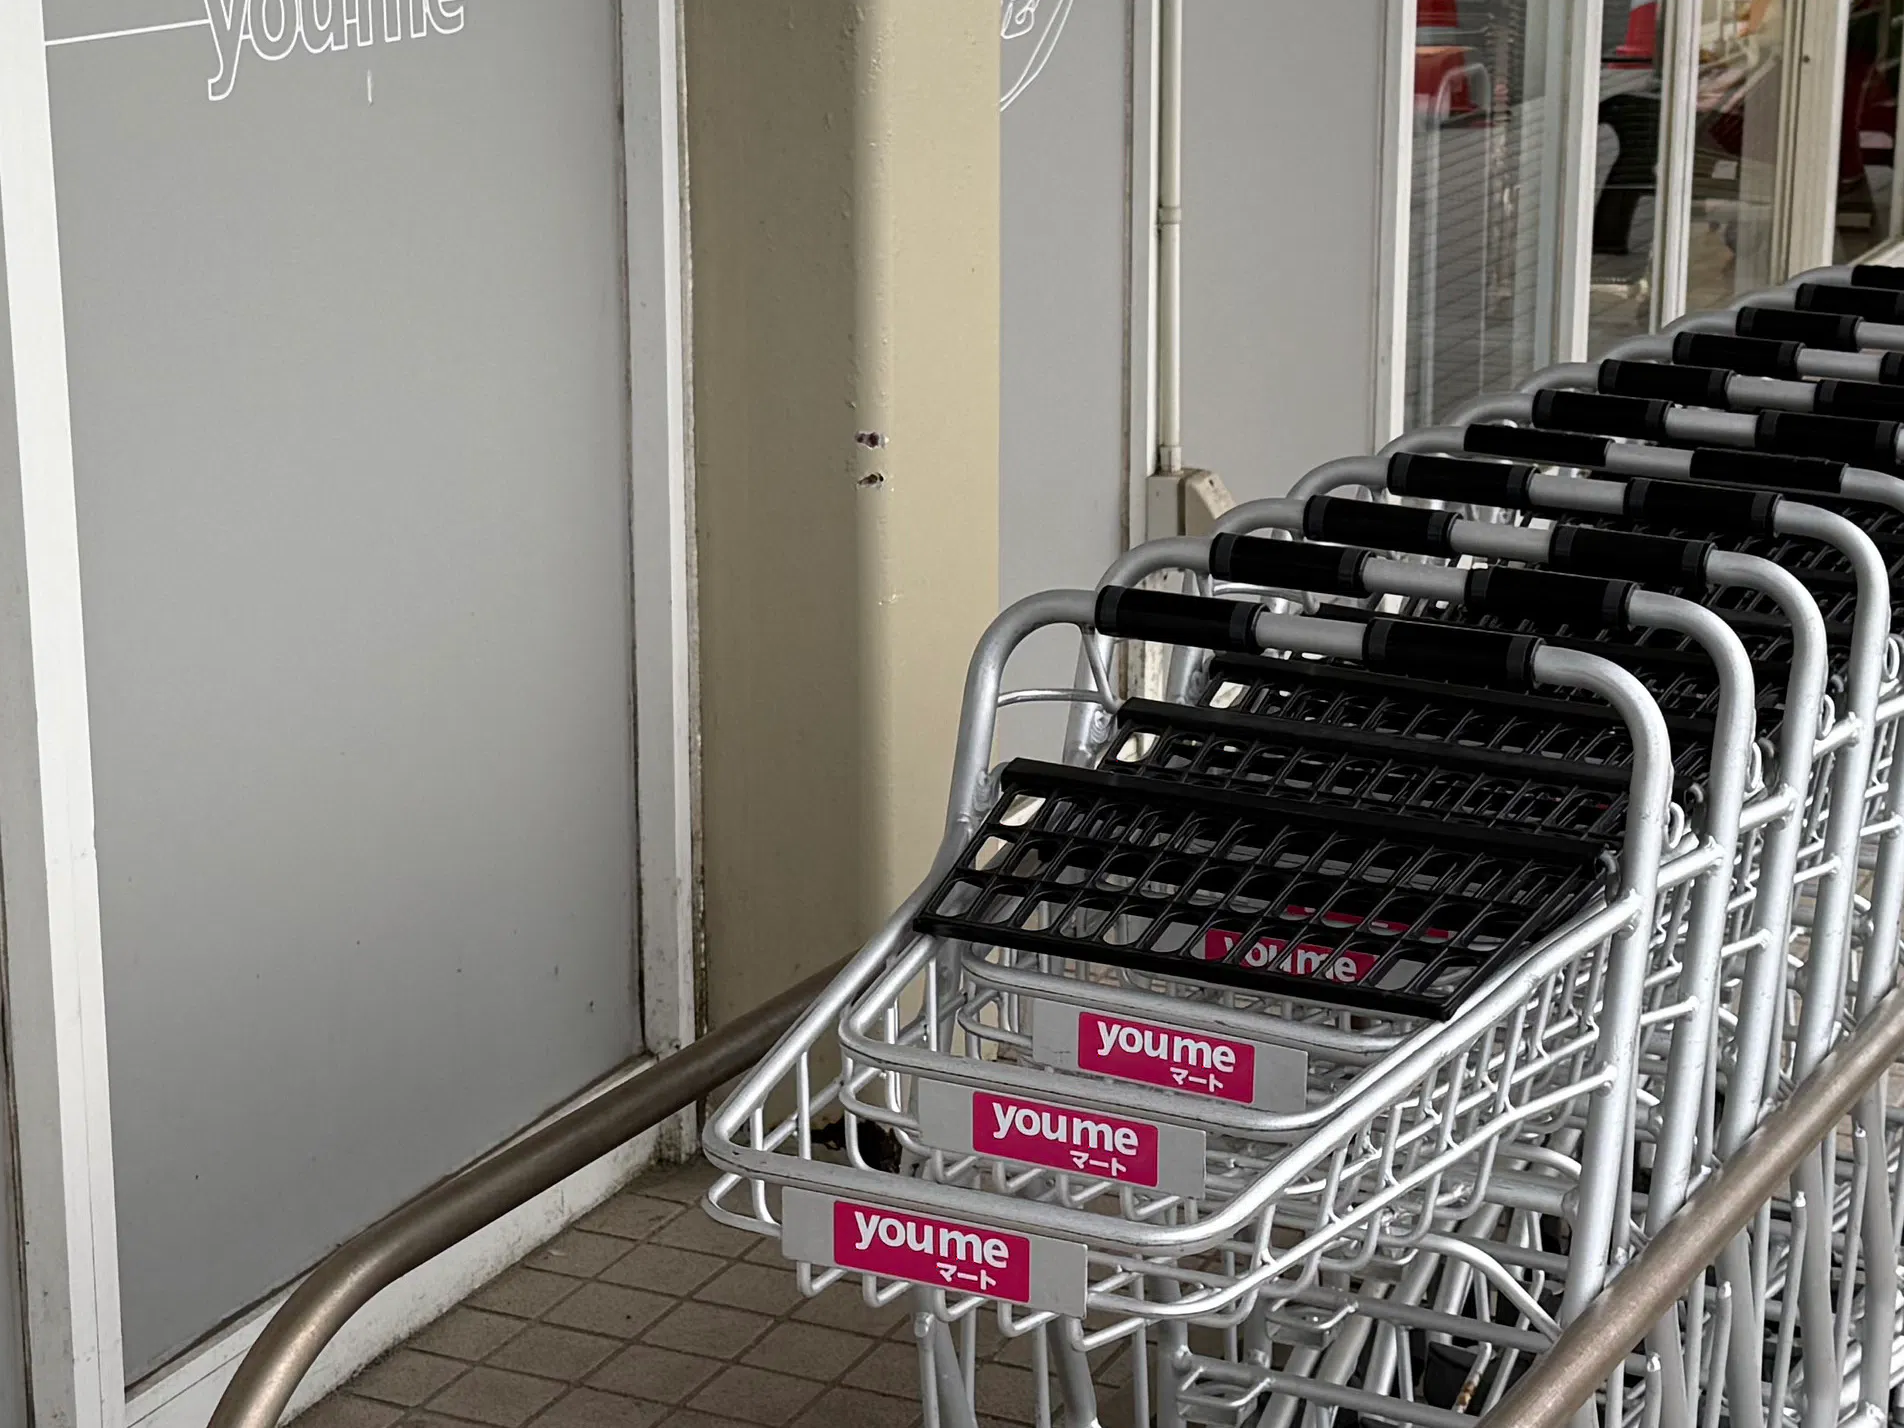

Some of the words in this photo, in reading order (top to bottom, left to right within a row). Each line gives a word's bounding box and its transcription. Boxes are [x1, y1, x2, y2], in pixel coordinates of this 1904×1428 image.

[1097, 1020, 1236, 1073] youme
[1170, 1066, 1224, 1093] マート
[992, 1102, 1139, 1156] youme
[1069, 1150, 1127, 1177] マート
[854, 1211, 1010, 1269] youme
[936, 1262, 997, 1290] マート
